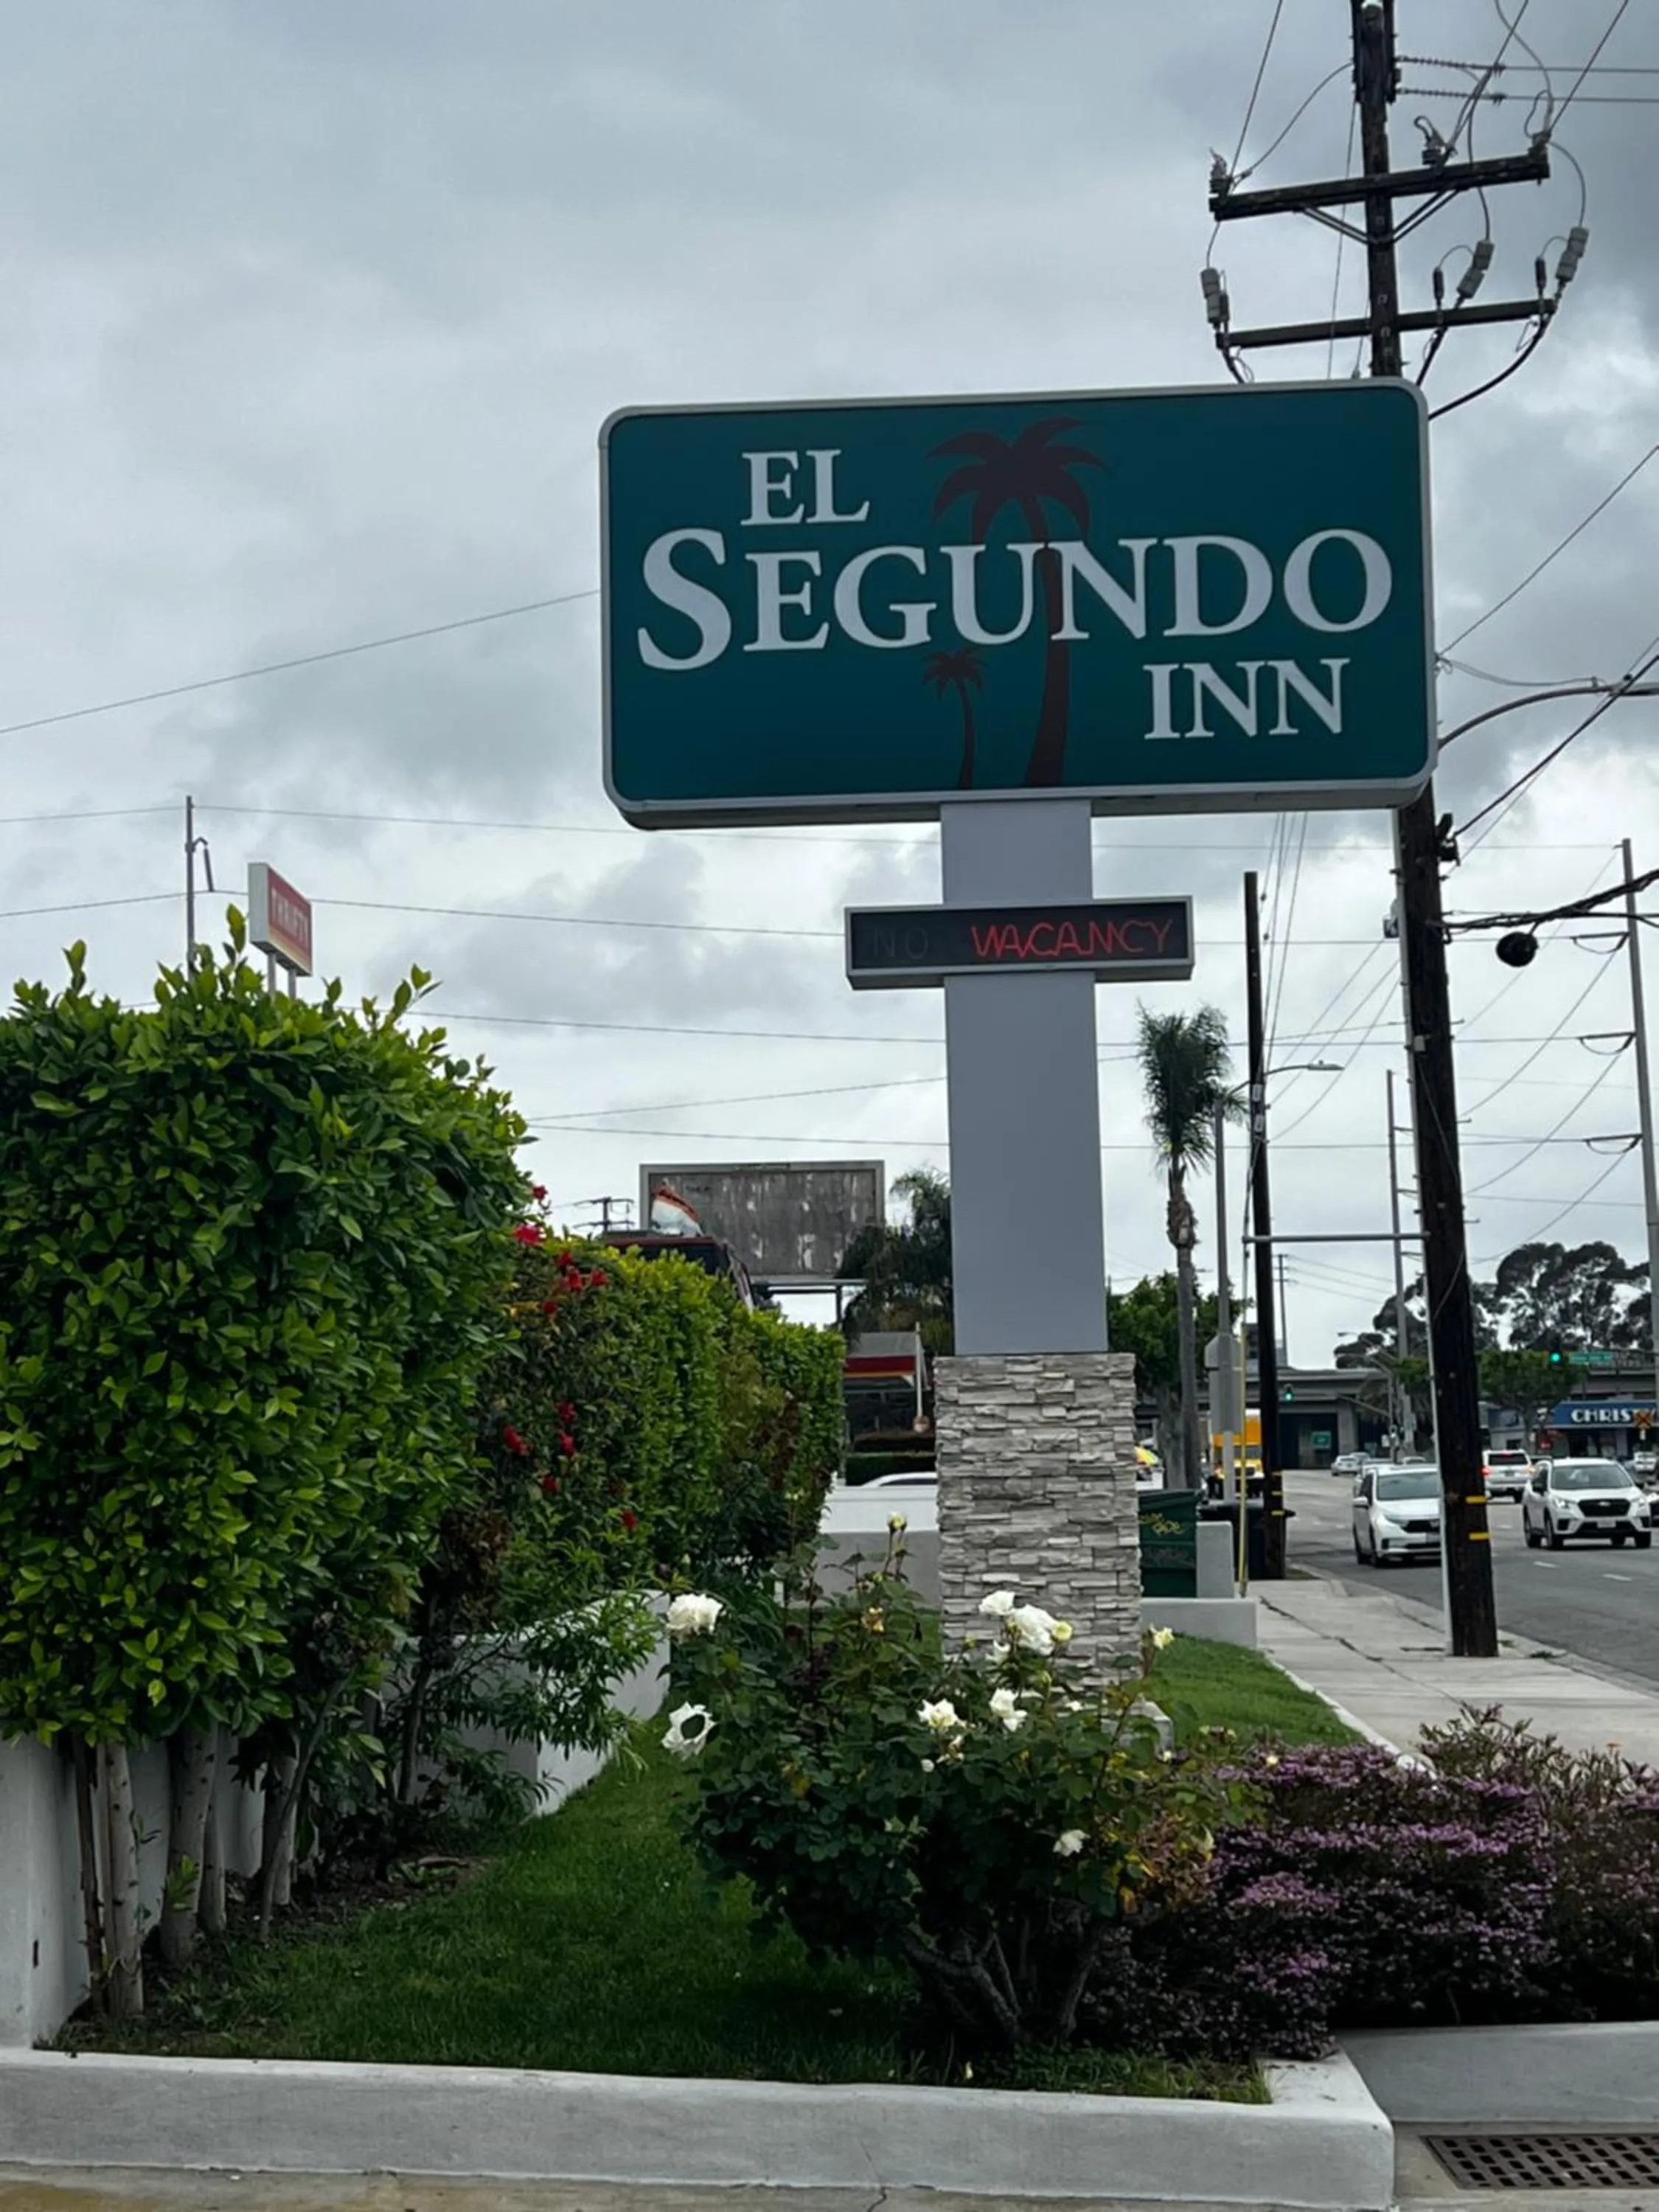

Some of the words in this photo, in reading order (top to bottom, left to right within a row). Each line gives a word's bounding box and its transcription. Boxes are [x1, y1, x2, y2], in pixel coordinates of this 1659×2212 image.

[740, 448, 870, 527] EL
[637, 527, 1394, 671] SEGUNDO
[1144, 658, 1352, 739] INN
[873, 925, 929, 959] NO
[970, 919, 1174, 959] VACANCY
